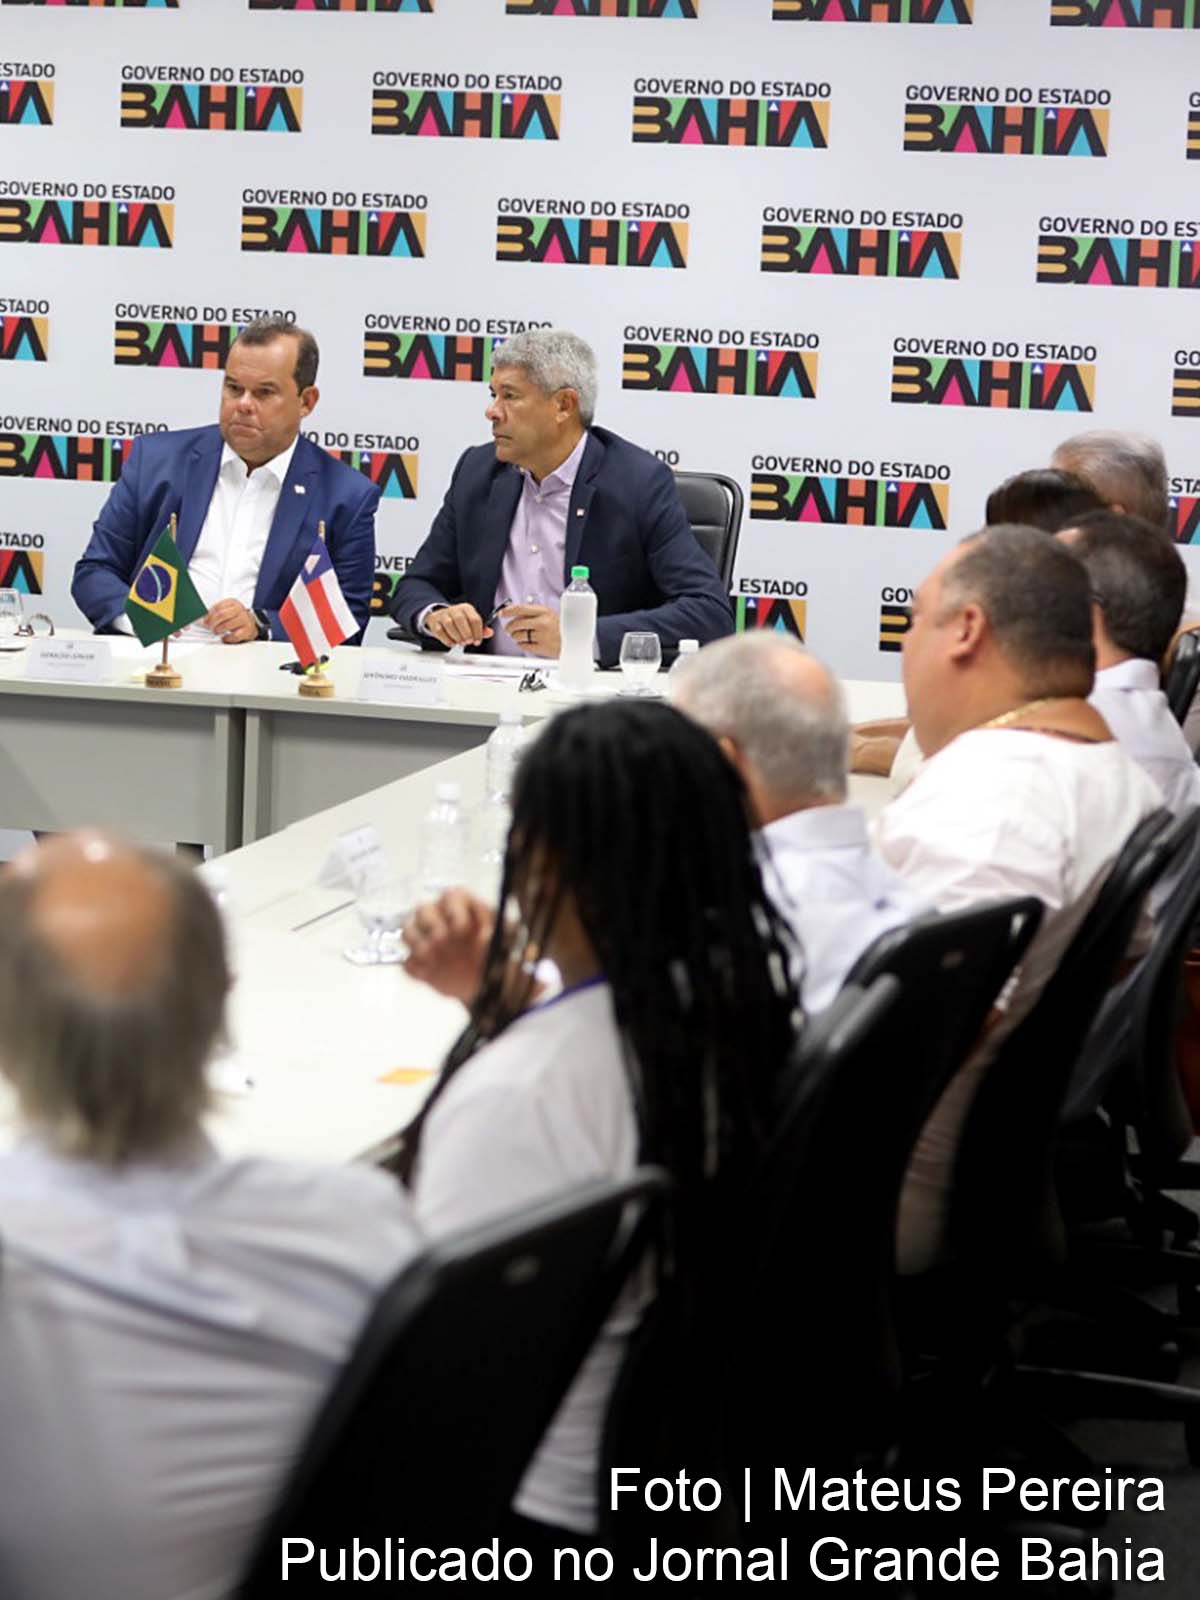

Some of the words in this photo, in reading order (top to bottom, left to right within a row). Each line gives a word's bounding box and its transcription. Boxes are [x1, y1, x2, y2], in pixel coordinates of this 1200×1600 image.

[121, 65, 205, 82] GOVERNO
[210, 67, 234, 83] DO
[239, 68, 304, 85] ESTADO
[372, 71, 460, 89] GOVERNO
[464, 73, 490, 89] DO
[495, 74, 562, 91] ESTADO
[633, 78, 724, 95] GOVERNO
[729, 80, 756, 97] DO
[761, 81, 832, 98] ESTADO
[905, 84, 1000, 103] GOVERNO
[1005, 87, 1033, 103] DO
[1038, 88, 1112, 105] ESTADO
[121, 83, 303, 132] BAHIA
[372, 90, 560, 140] BAHIA
[633, 97, 830, 148] BAHIA
[904, 104, 1109, 156] BAHIA
[83, 183, 107, 199] DO
[112, 184, 176, 201] ESTADO
[242, 188, 327, 206] GOVERNO
[332, 191, 357, 207] DO
[362, 192, 428, 209] ESTADO
[497, 198, 586, 215] GOVERNO
[590, 201, 617, 216] DO
[621, 202, 690, 219] ESTADO
[762, 207, 855, 225] GOVERNO
[860, 210, 887, 226] DO
[892, 211, 963, 229] ESTADO
[242, 207, 426, 257] BAHIA
[1038, 216, 1135, 235] GOVERNO
[1140, 220, 1168, 236] DO
[496, 216, 688, 268] BAHIA
[761, 226, 961, 279] BAHIA
[1037, 235, 1200, 288] BAHI
[115, 303, 198, 321] GOVERNO
[203, 307, 227, 322] DO
[364, 313, 451, 332] GOVERNO
[455, 318, 481, 334] DO
[115, 321, 240, 369] BAH
[623, 326, 713, 344] GOVERNO
[718, 330, 745, 346] DO
[750, 331, 820, 348] ESTADO
[363, 331, 497, 382] BAH
[893, 337, 987, 357] GOVERNO
[992, 341, 1020, 358] DO
[1025, 343, 1097, 360] ESTADO
[622, 344, 817, 398] BAHIA
[892, 357, 1095, 412] BAHIA
[77, 419, 101, 435] DO
[324, 432, 349, 447] DO
[354, 433, 420, 450] ESTADO
[751, 455, 843, 475] GOVERNO
[847, 460, 875, 476] DO
[880, 461, 951, 479] ESTADO
[750, 474, 949, 530] BAHIA
[739, 578, 808, 596] ESTADO
